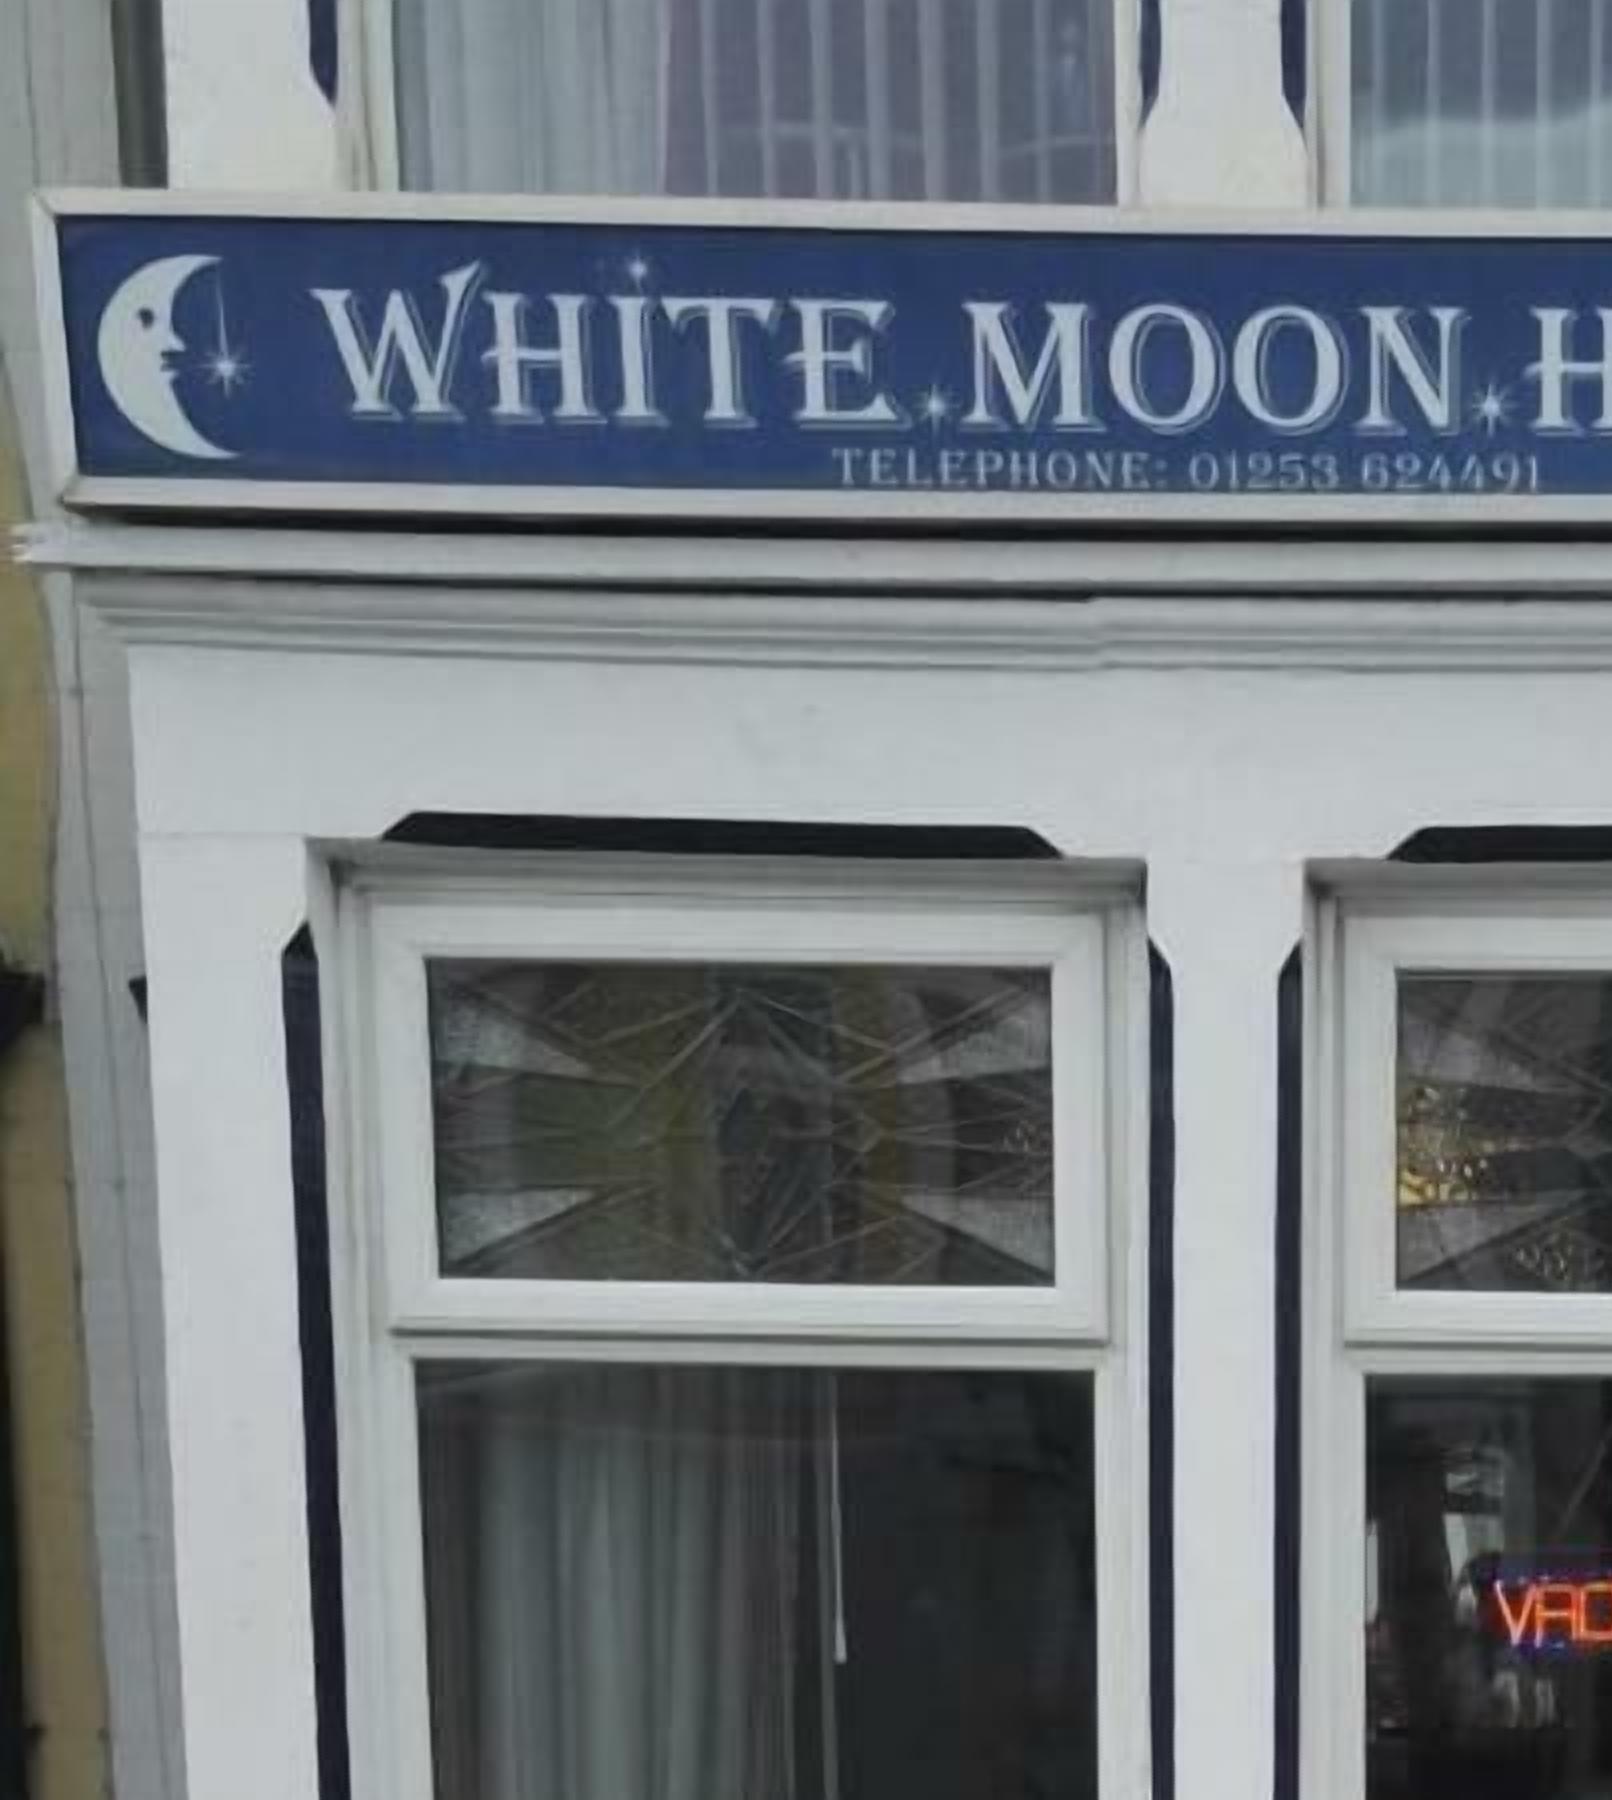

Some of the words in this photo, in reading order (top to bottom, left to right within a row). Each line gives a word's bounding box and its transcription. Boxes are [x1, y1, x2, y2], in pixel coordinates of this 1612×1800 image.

[308, 259, 910, 427] WHITE
[960, 300, 1470, 434] MOON
[831, 447, 1168, 490] TELEPHONE:
[1188, 450, 1340, 490] 01253
[1360, 451, 1539, 492] 624491
